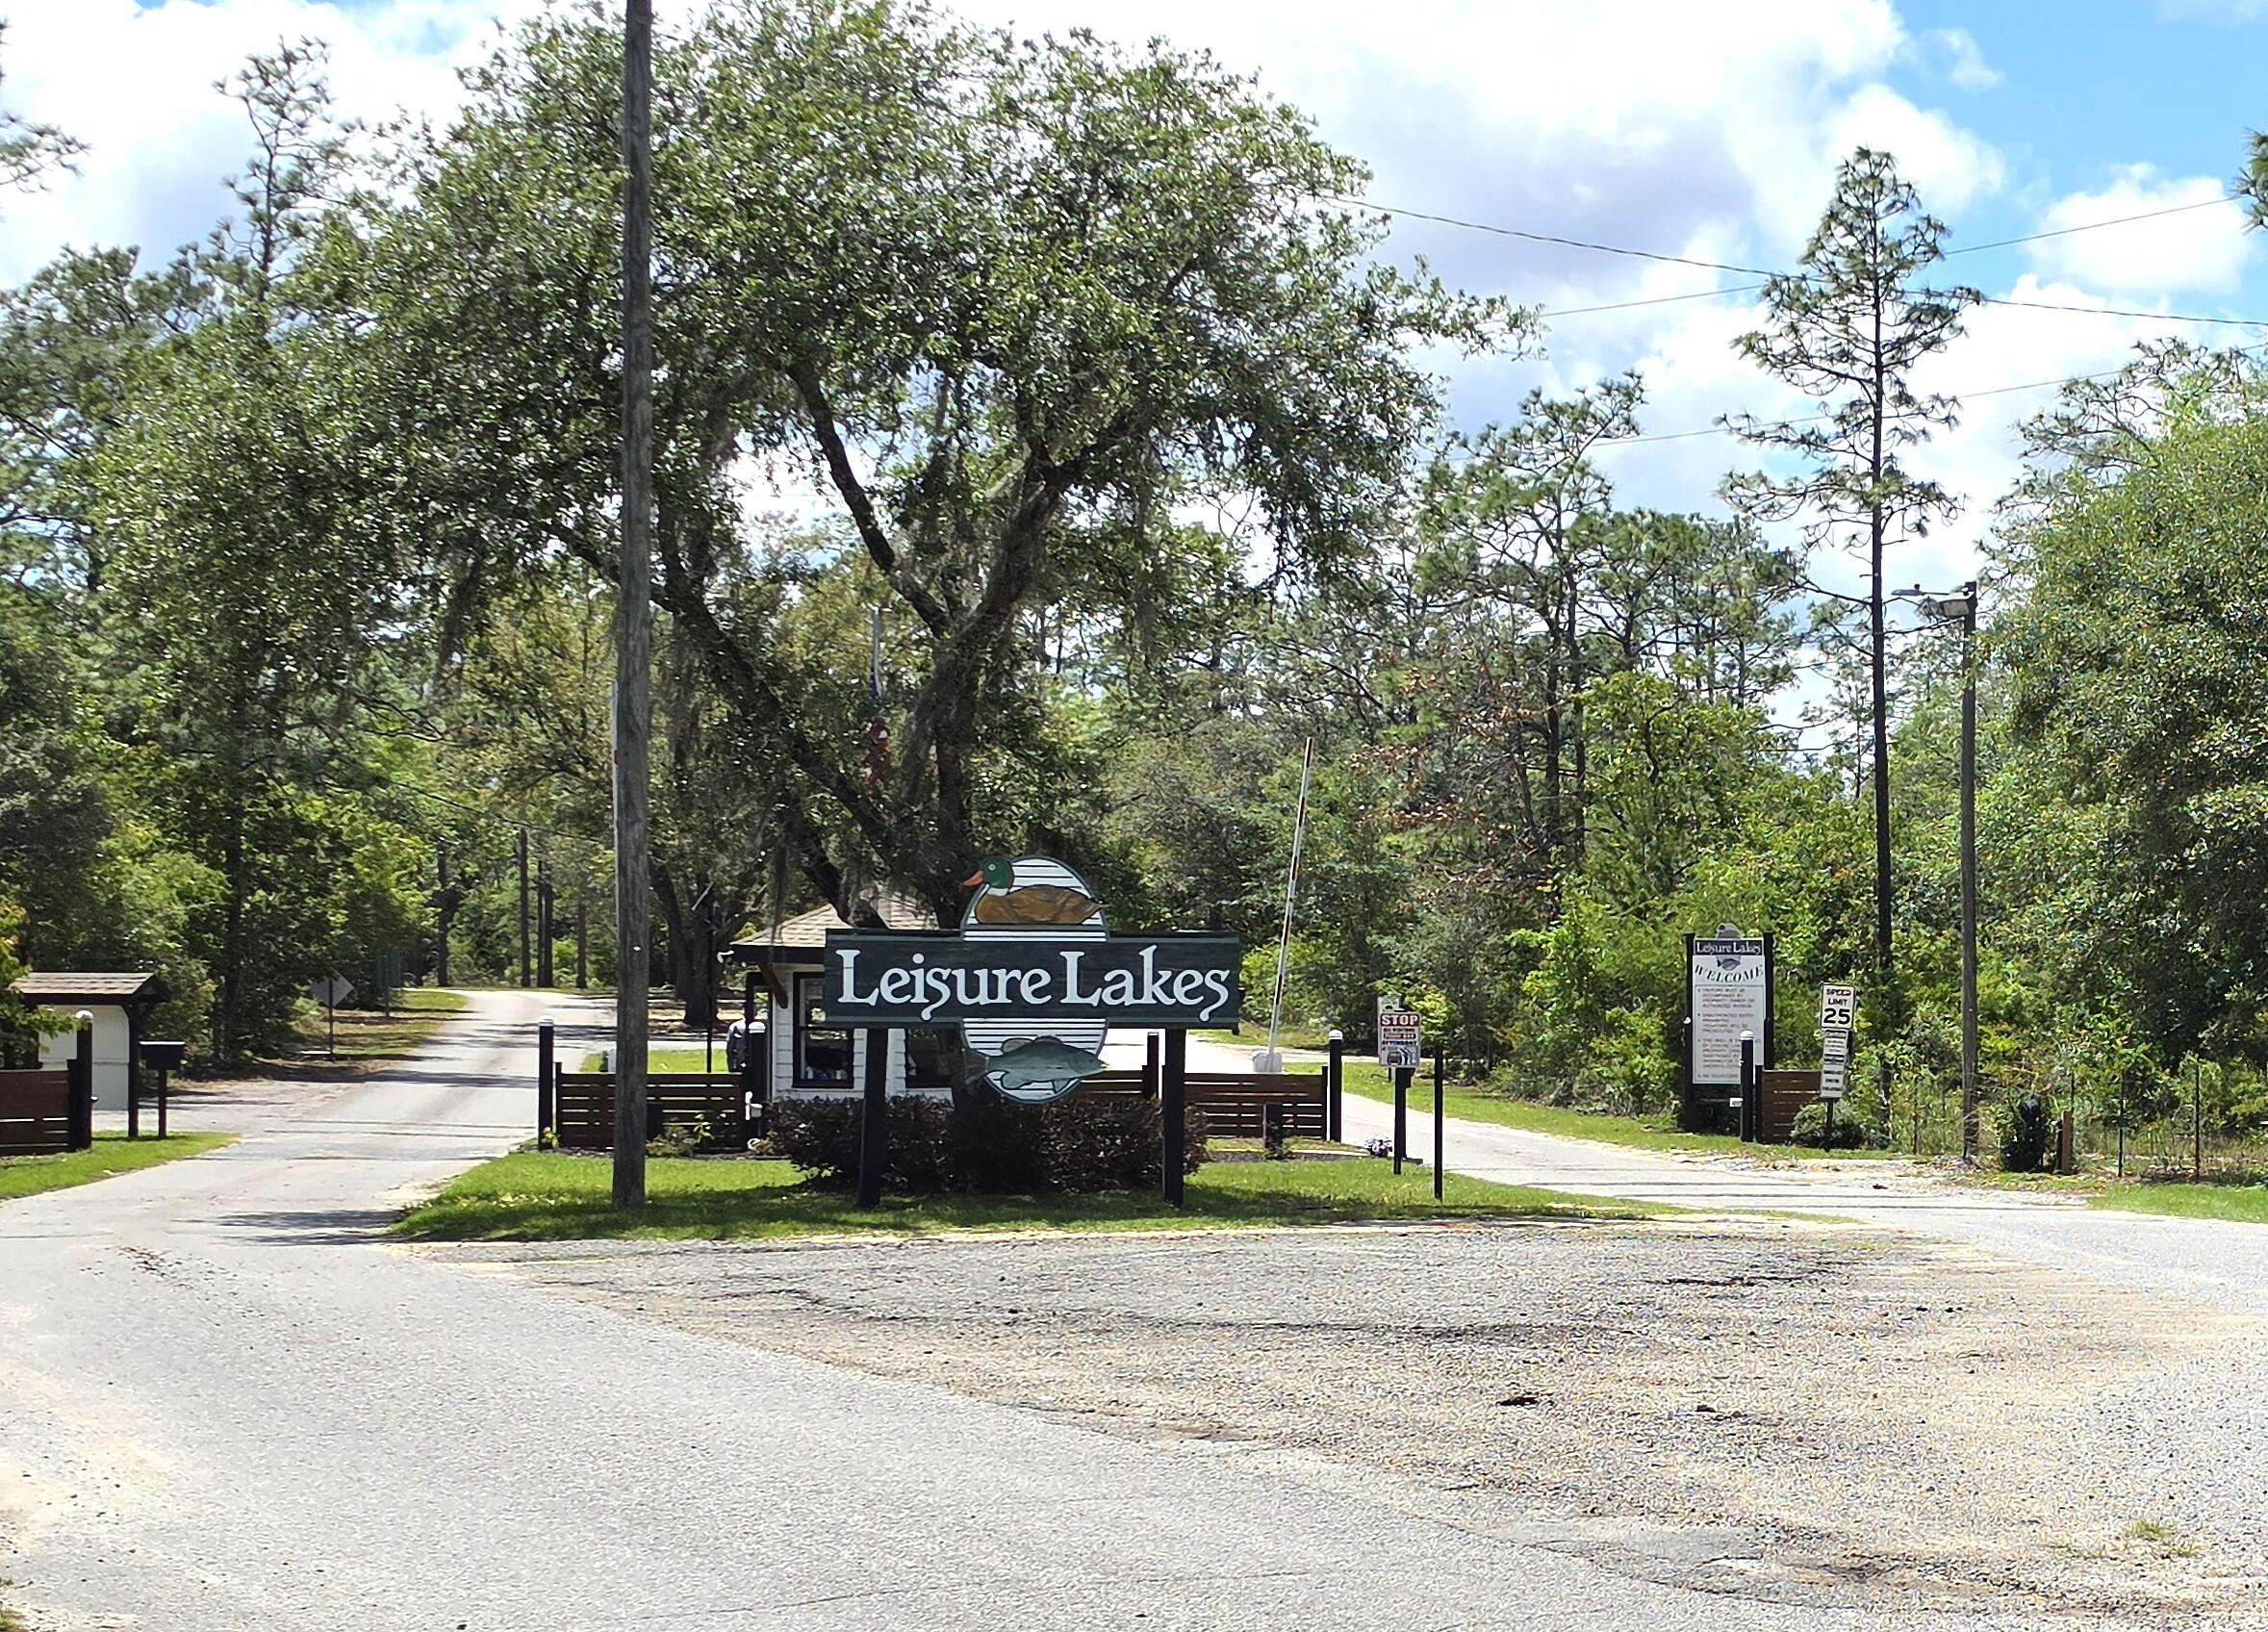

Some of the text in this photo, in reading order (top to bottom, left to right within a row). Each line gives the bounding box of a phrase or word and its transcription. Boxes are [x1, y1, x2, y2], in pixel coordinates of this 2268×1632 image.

[1696, 941, 1761, 955] Leisure Lakes
[1695, 963, 1764, 983] WELCOME
[835, 944, 1231, 1022] Leisure Lakes
[1826, 988, 1851, 997] SPEED
[1827, 998, 1848, 1007] LIMIT
[1382, 1015, 1418, 1026] STOP
[1823, 1007, 1851, 1025] 25
